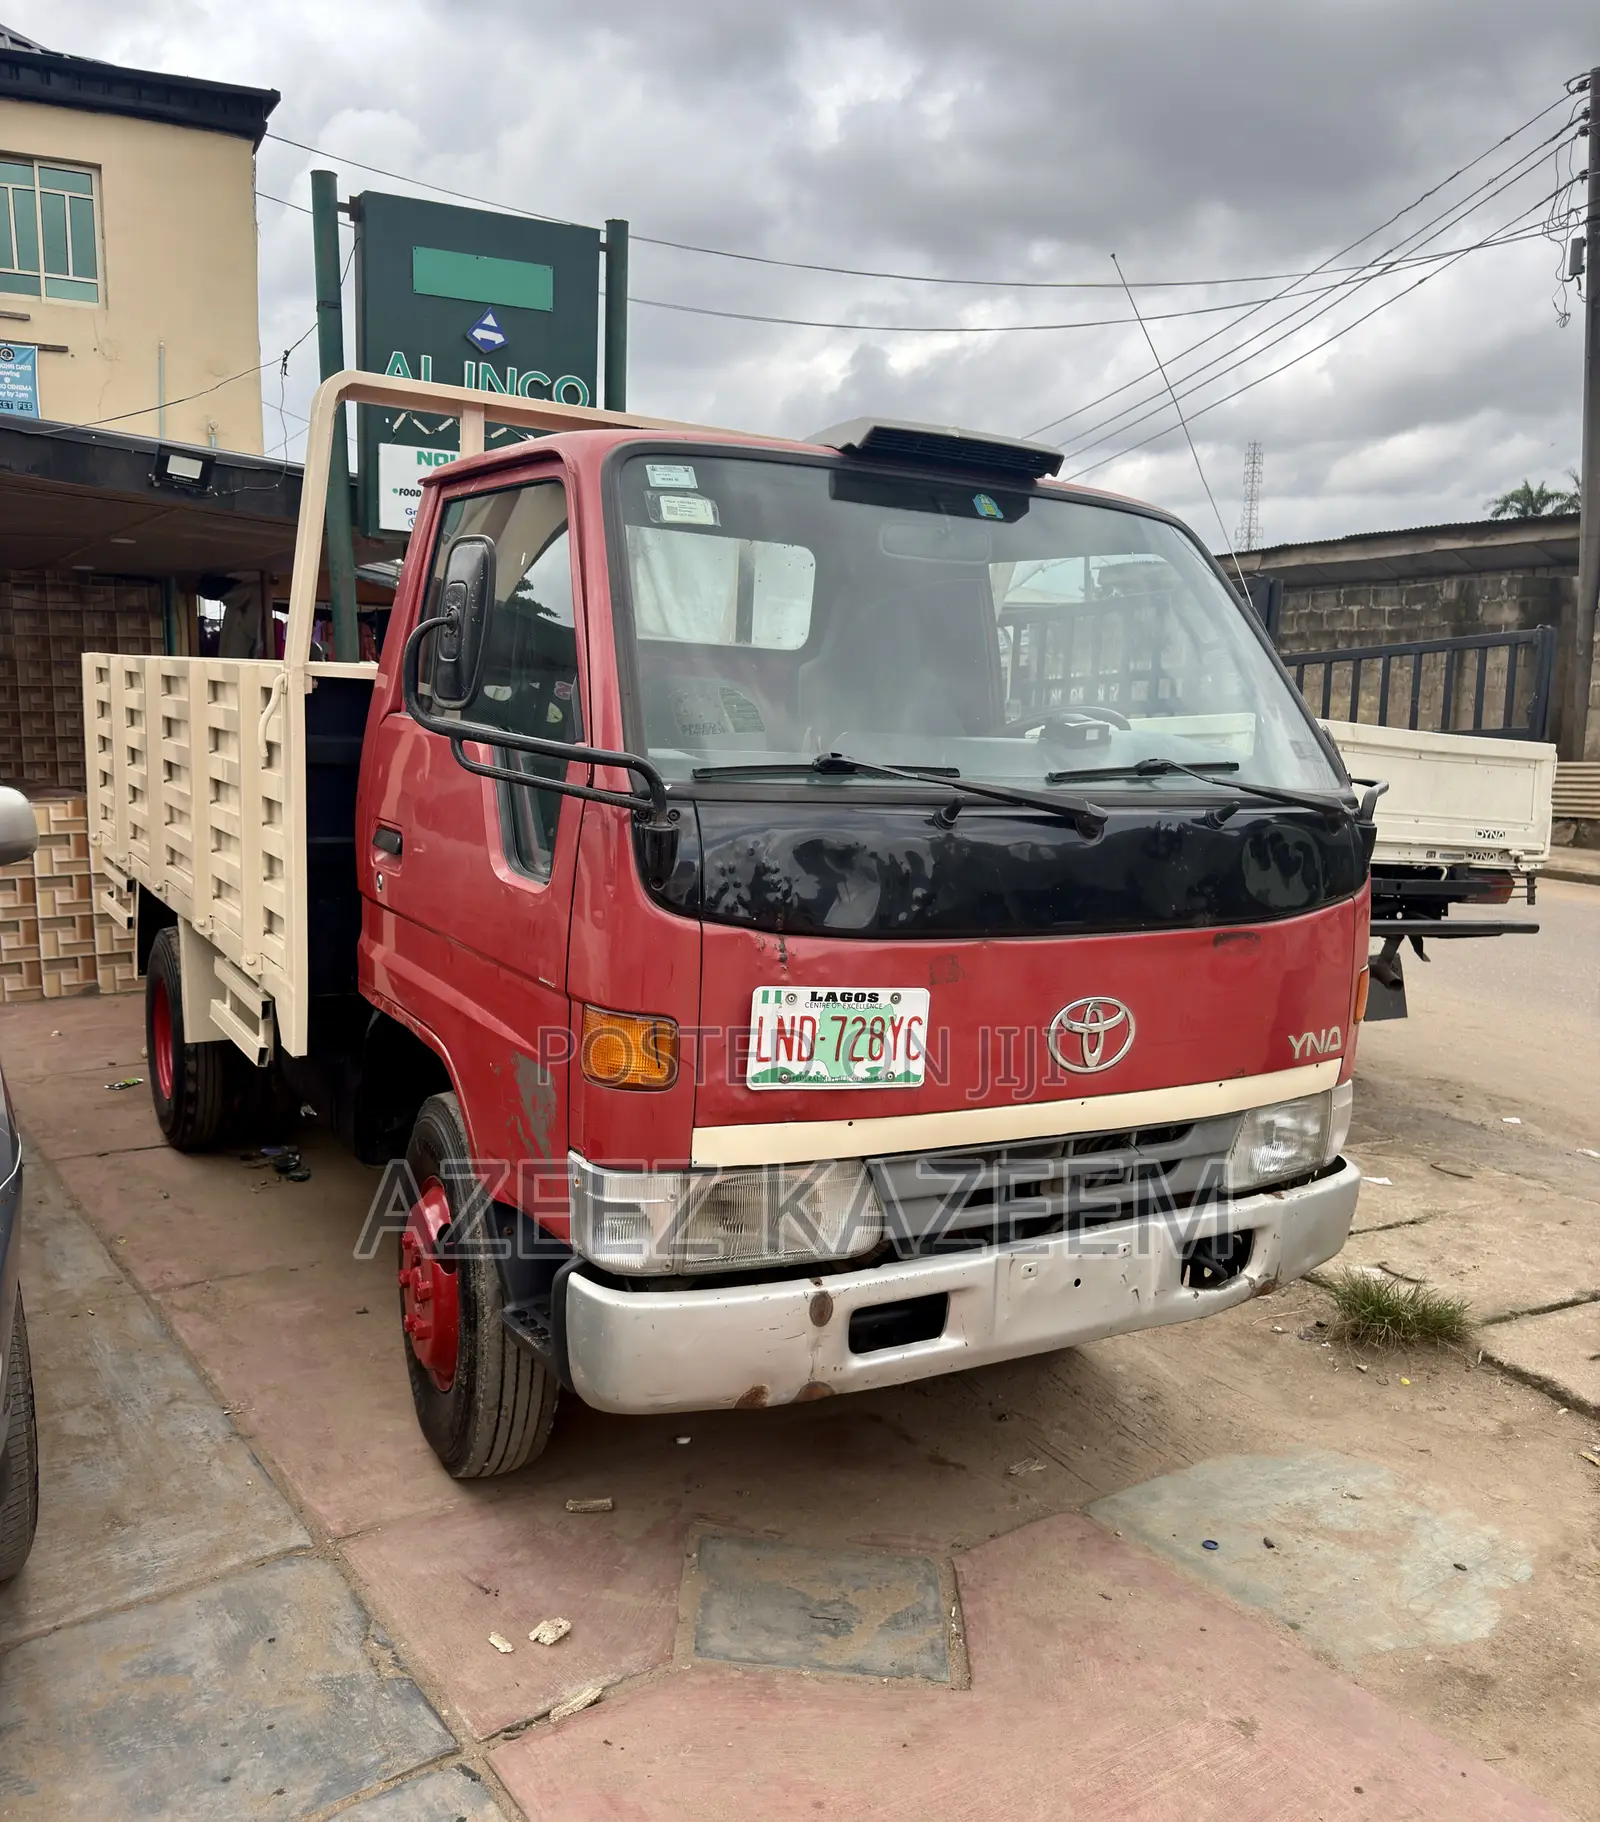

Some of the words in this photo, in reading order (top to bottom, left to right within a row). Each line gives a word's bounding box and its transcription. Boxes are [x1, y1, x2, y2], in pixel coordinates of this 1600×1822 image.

[18, 402, 33, 410] FEE
[398, 487, 422, 498] FOOD
[1475, 829, 1506, 840] DYNA
[1465, 851, 1497, 861] DYNA
[809, 991, 880, 1003] LAGOS
[804, 1001, 831, 1009] CENTRE
[842, 1002, 883, 1010] EXCELLENCE
[1288, 1025, 1342, 1060] YNA
